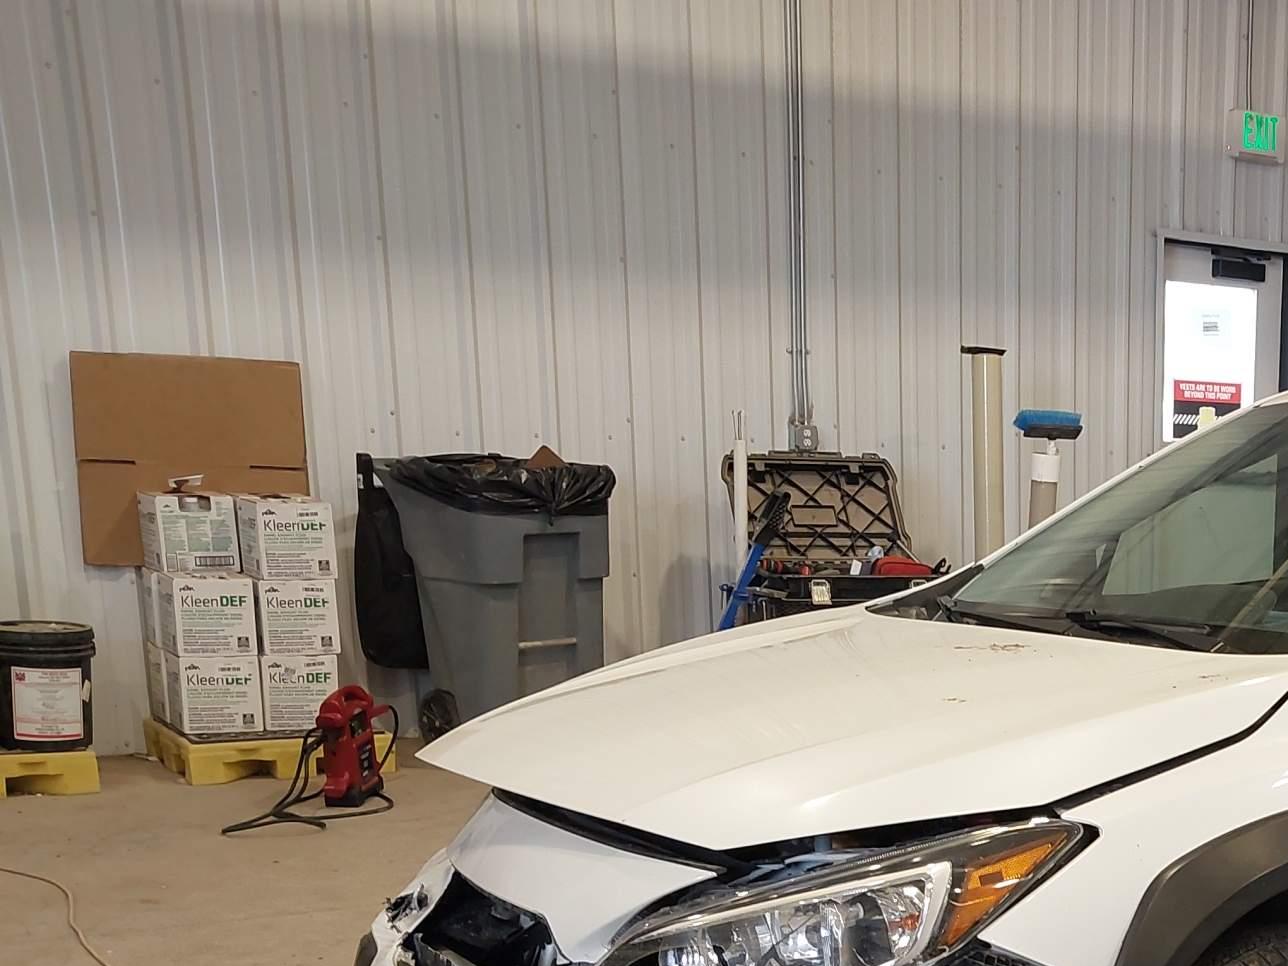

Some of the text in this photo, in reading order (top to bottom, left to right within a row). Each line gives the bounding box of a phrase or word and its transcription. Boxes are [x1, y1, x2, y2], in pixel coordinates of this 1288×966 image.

[1244, 112, 1279, 152] EXIT
[1179, 383, 1195, 391] VESTS
[1207, 384, 1213, 392] TO
[1216, 392, 1232, 400] POINT
[181, 595, 248, 608] KleenDEF
